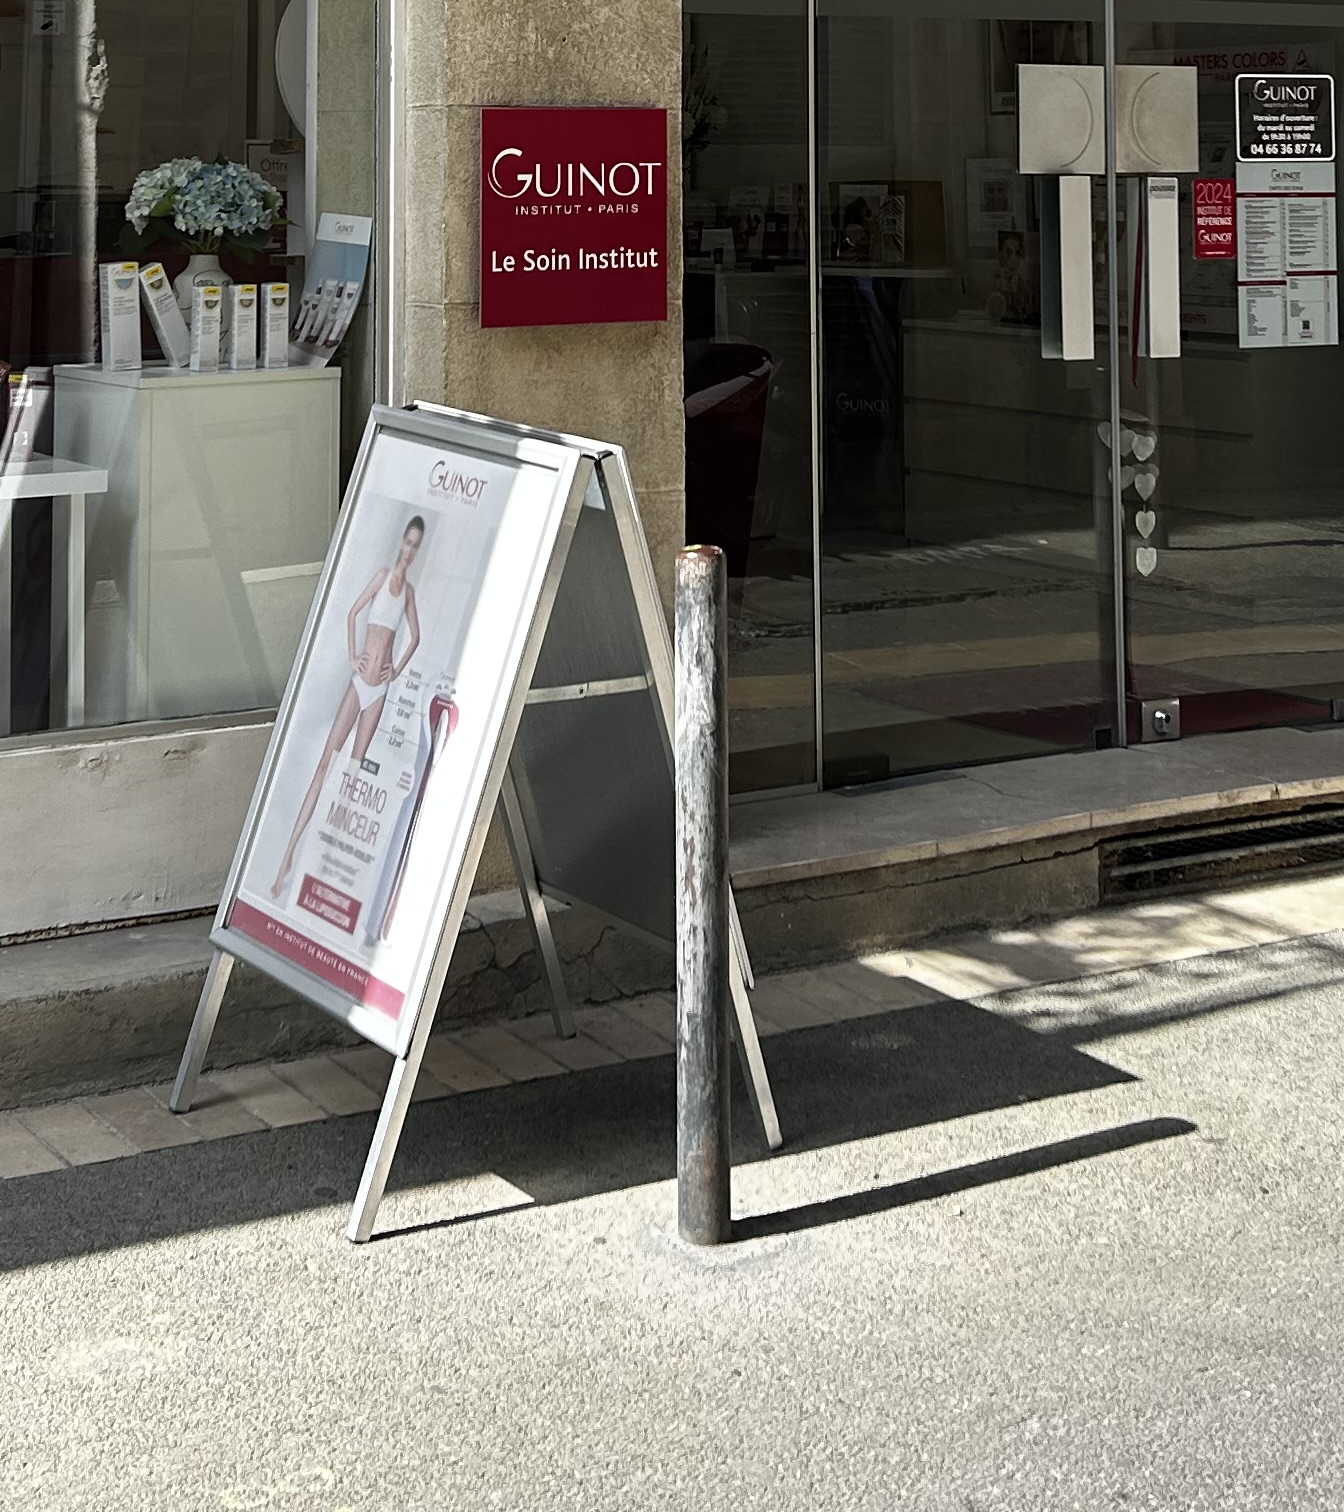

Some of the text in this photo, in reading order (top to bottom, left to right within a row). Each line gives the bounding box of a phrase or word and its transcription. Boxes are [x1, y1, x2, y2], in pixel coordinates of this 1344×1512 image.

[1233, 51, 1285, 68] COLORS
[1253, 79, 1317, 101] GUINOT
[1251, 144, 1264, 155] 04
[1309, 144, 1322, 154] 74
[487, 148, 662, 199] GUINOT
[1196, 182, 1232, 204] 2024
[515, 204, 639, 216] INSTITUT PARIS
[492, 246, 658, 272] Le Soin Institut
[429, 460, 488, 500] GUINOT
[339, 771, 387, 815] THERMO
[326, 801, 380, 847] MINCEUR
